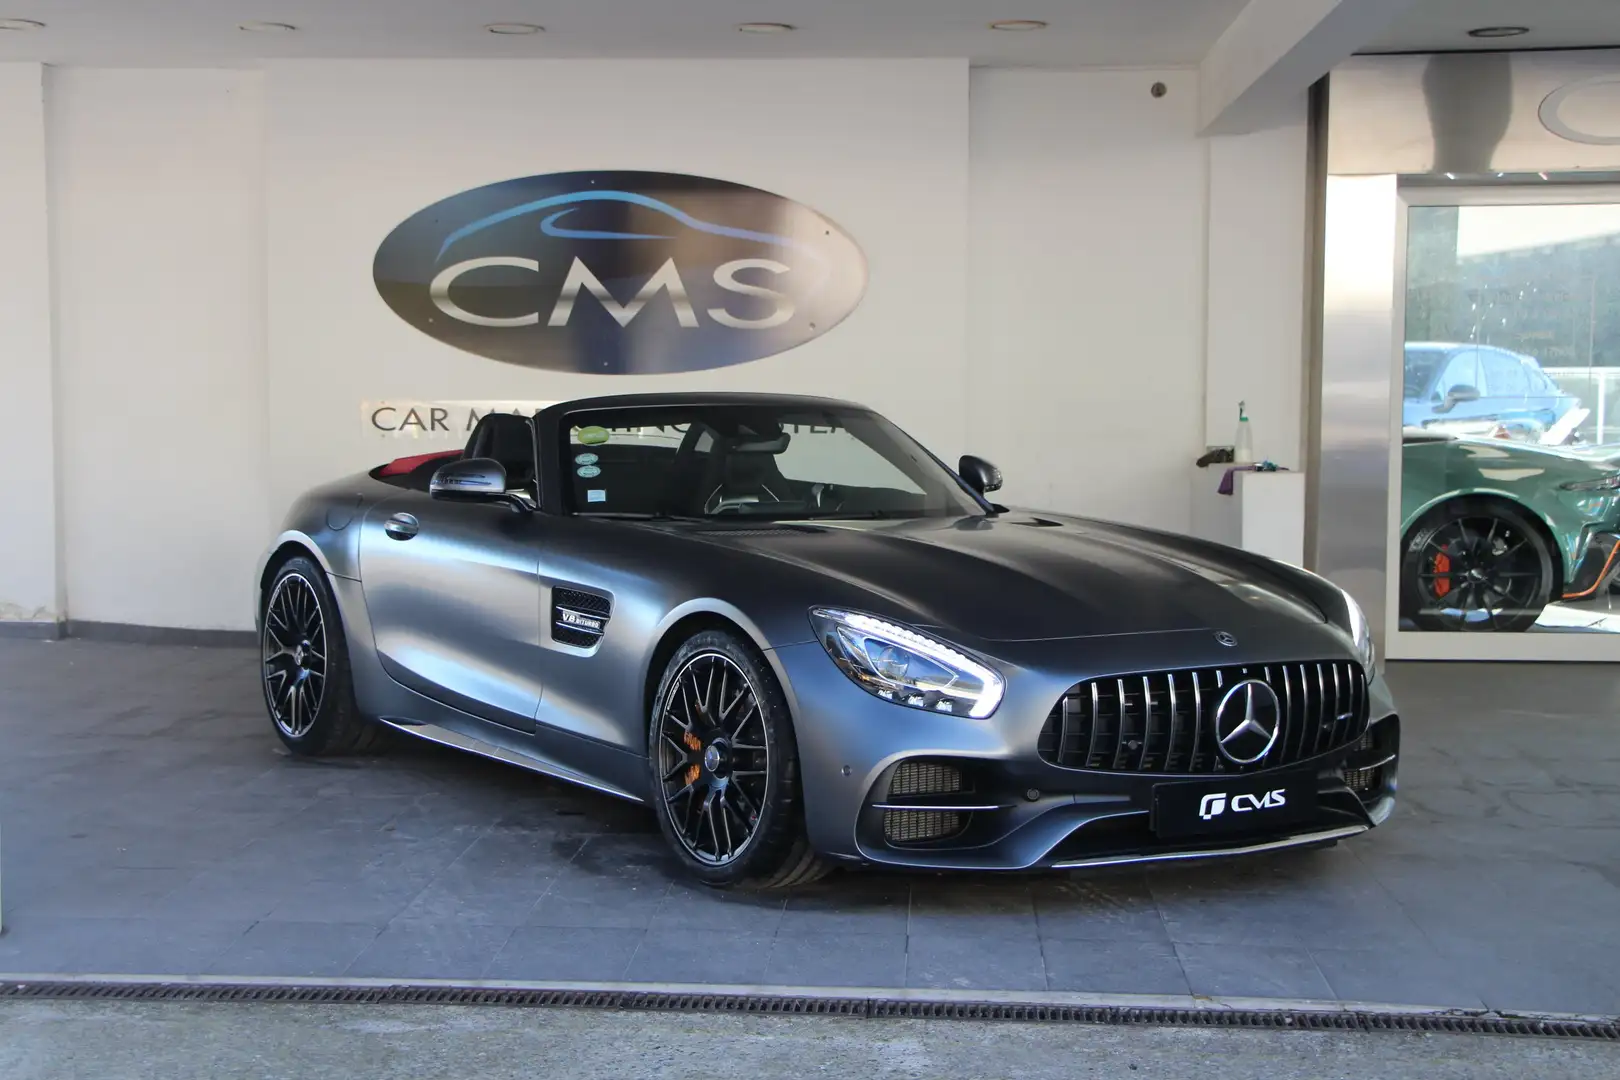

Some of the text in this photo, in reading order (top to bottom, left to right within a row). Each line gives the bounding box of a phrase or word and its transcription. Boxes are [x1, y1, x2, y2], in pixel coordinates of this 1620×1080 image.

[429, 256, 796, 329] CMS
[371, 407, 450, 432] CAR
[562, 613, 576, 623] V8
[1231, 788, 1286, 812] CMS
